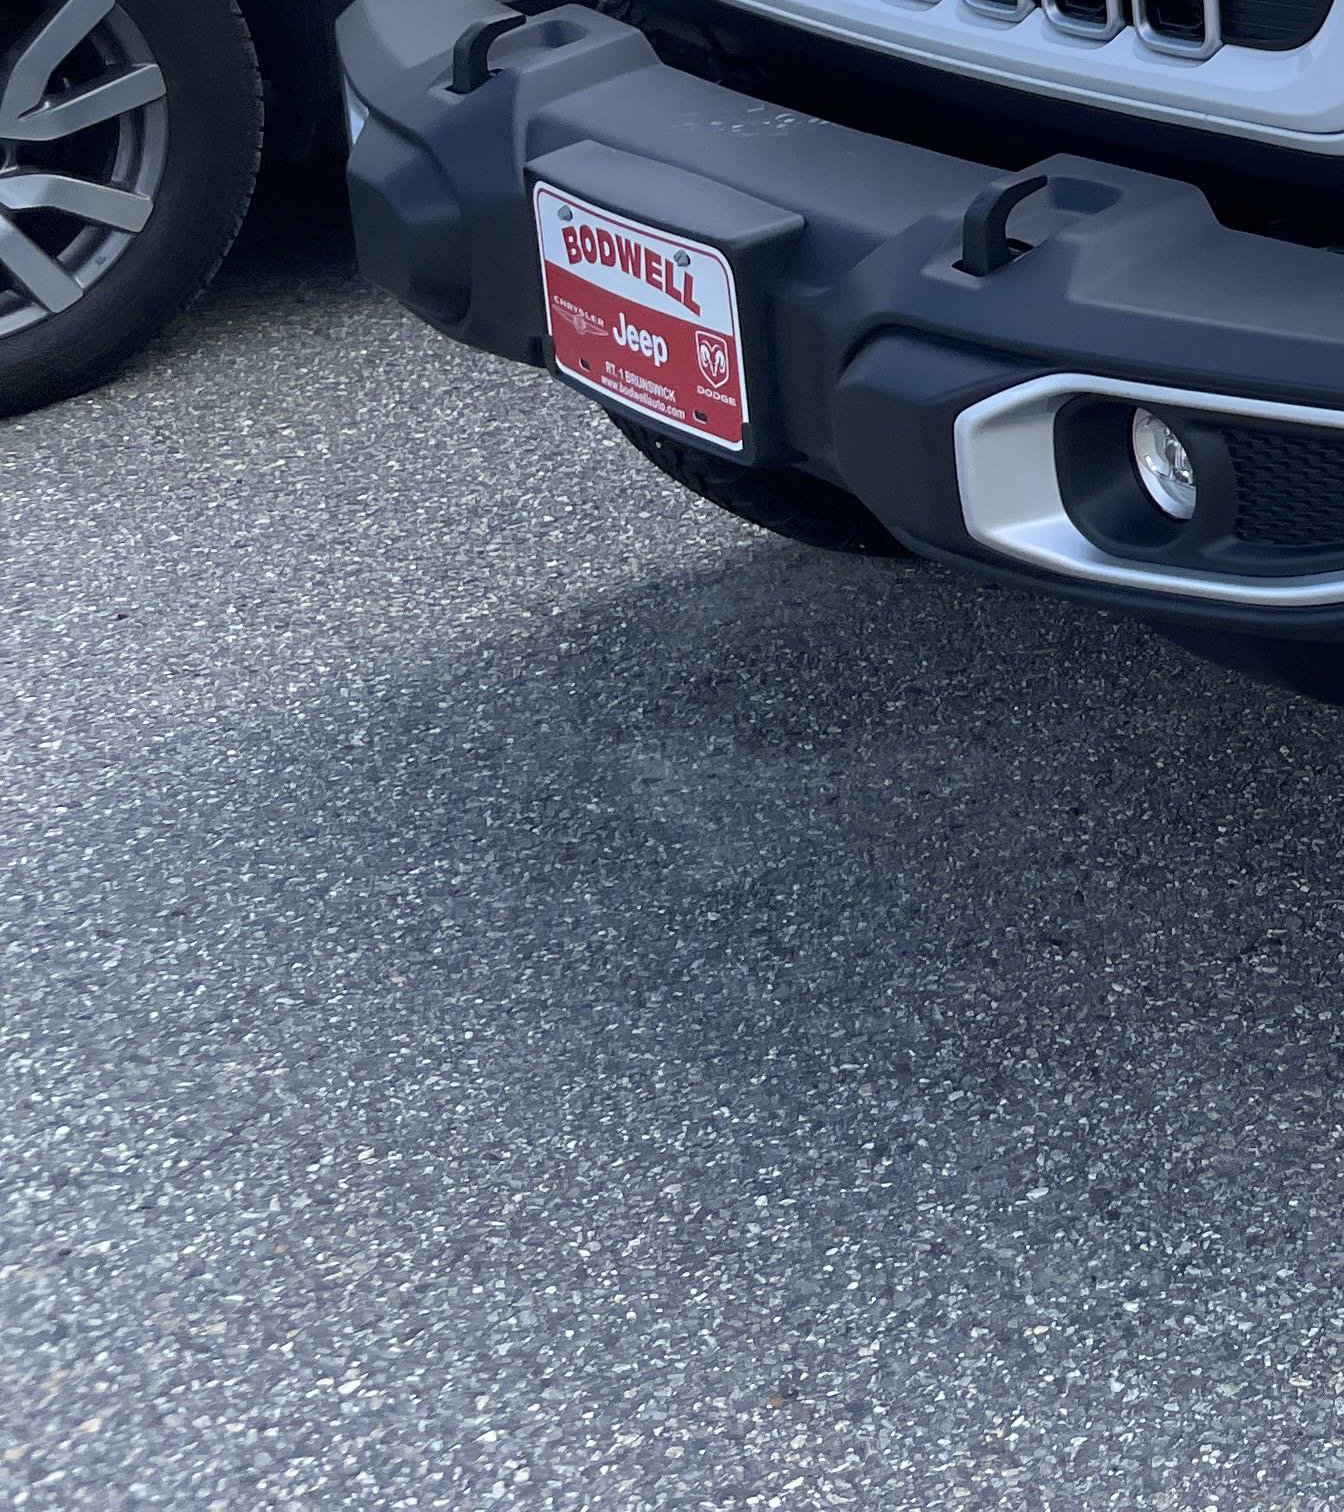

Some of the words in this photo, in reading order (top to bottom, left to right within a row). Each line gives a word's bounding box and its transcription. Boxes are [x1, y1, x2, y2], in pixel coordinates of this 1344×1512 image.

[562, 225, 701, 317] BODWELL
[553, 295, 605, 328] CHRYSLER
[613, 312, 668, 367] Jeep
[600, 375, 686, 421] www.bodwellauto.com
[624, 370, 677, 403] BRUNSWICK
[696, 385, 737, 407] DODGE
